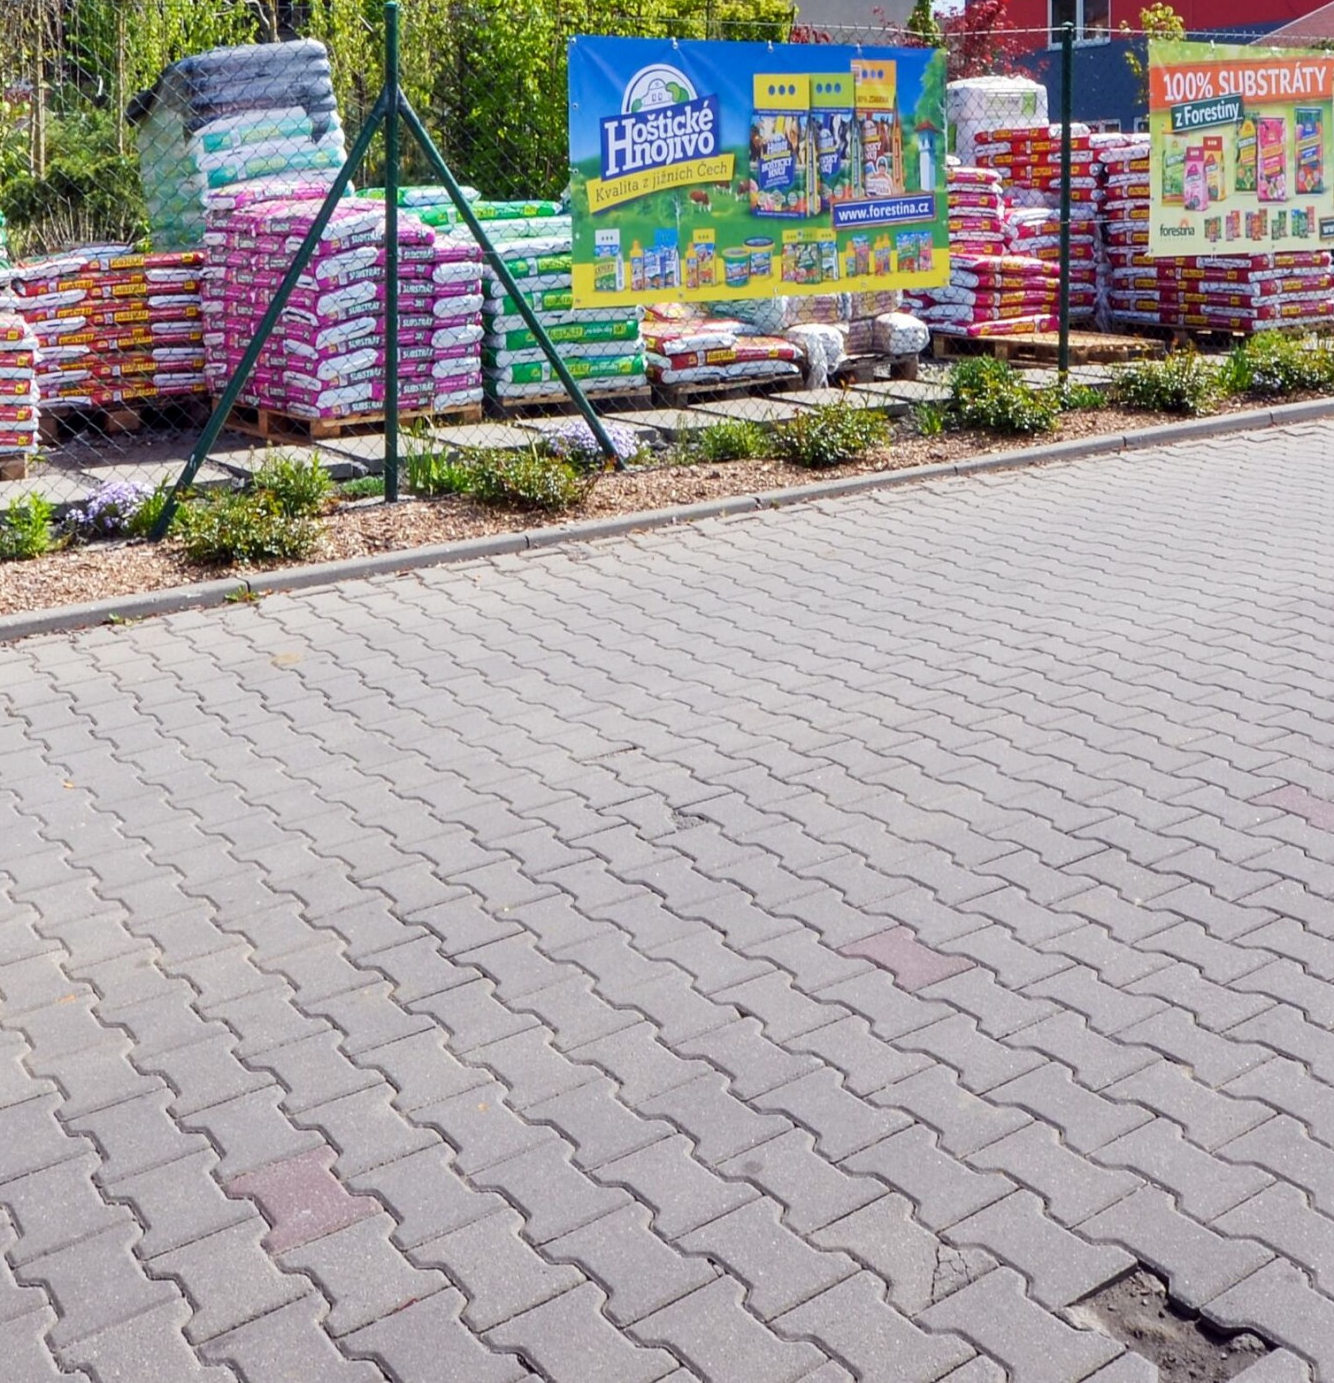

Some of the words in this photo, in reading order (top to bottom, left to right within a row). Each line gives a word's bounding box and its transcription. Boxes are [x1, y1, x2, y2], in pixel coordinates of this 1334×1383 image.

[1164, 71, 1213, 101] 100%
[1218, 62, 1326, 97] SUBSTRÁTY
[1175, 112, 1183, 127] z
[1184, 100, 1239, 125] Forestiny
[604, 100, 714, 173] Hoštické
[595, 181, 639, 202] Kvalita
[697, 161, 728, 177] Čech
[838, 201, 930, 222] www.forestina.cz
